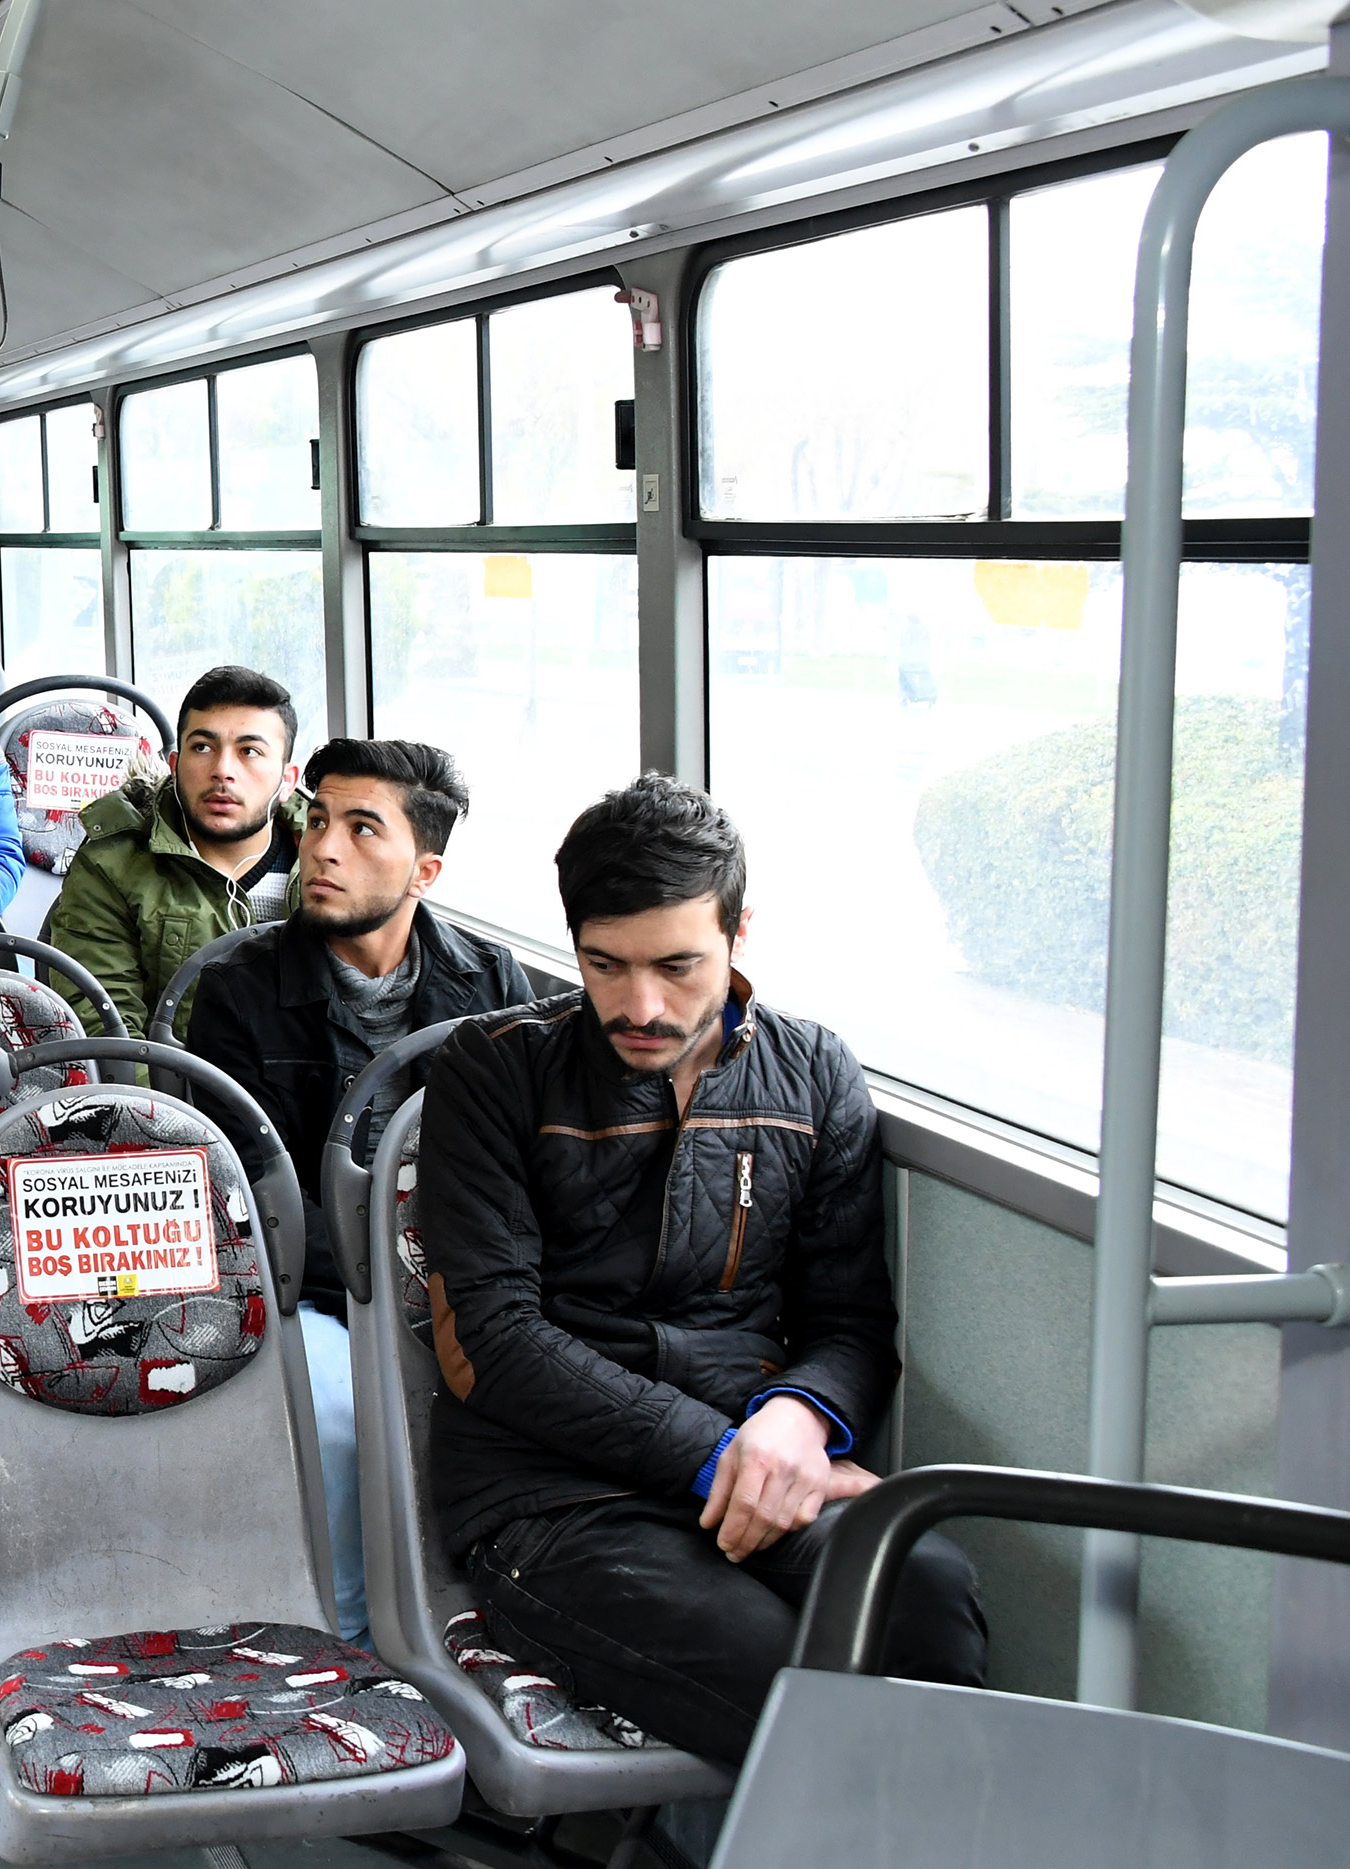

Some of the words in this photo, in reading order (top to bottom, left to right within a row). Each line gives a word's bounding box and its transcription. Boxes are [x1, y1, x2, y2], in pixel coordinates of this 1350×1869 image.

[36, 741, 72, 752] SOSYAL
[35, 752, 124, 769] KORUYUNUZ
[34, 769, 54, 782] BU
[23, 1176, 89, 1192] SOSYAL
[24, 1190, 185, 1219] KORUYUNUZ
[26, 1229, 62, 1252] BU
[73, 1218, 201, 1249] KOLTUĞU
[28, 1255, 72, 1276] BOŞ
[78, 1248, 191, 1274] BIRAKINIZ
